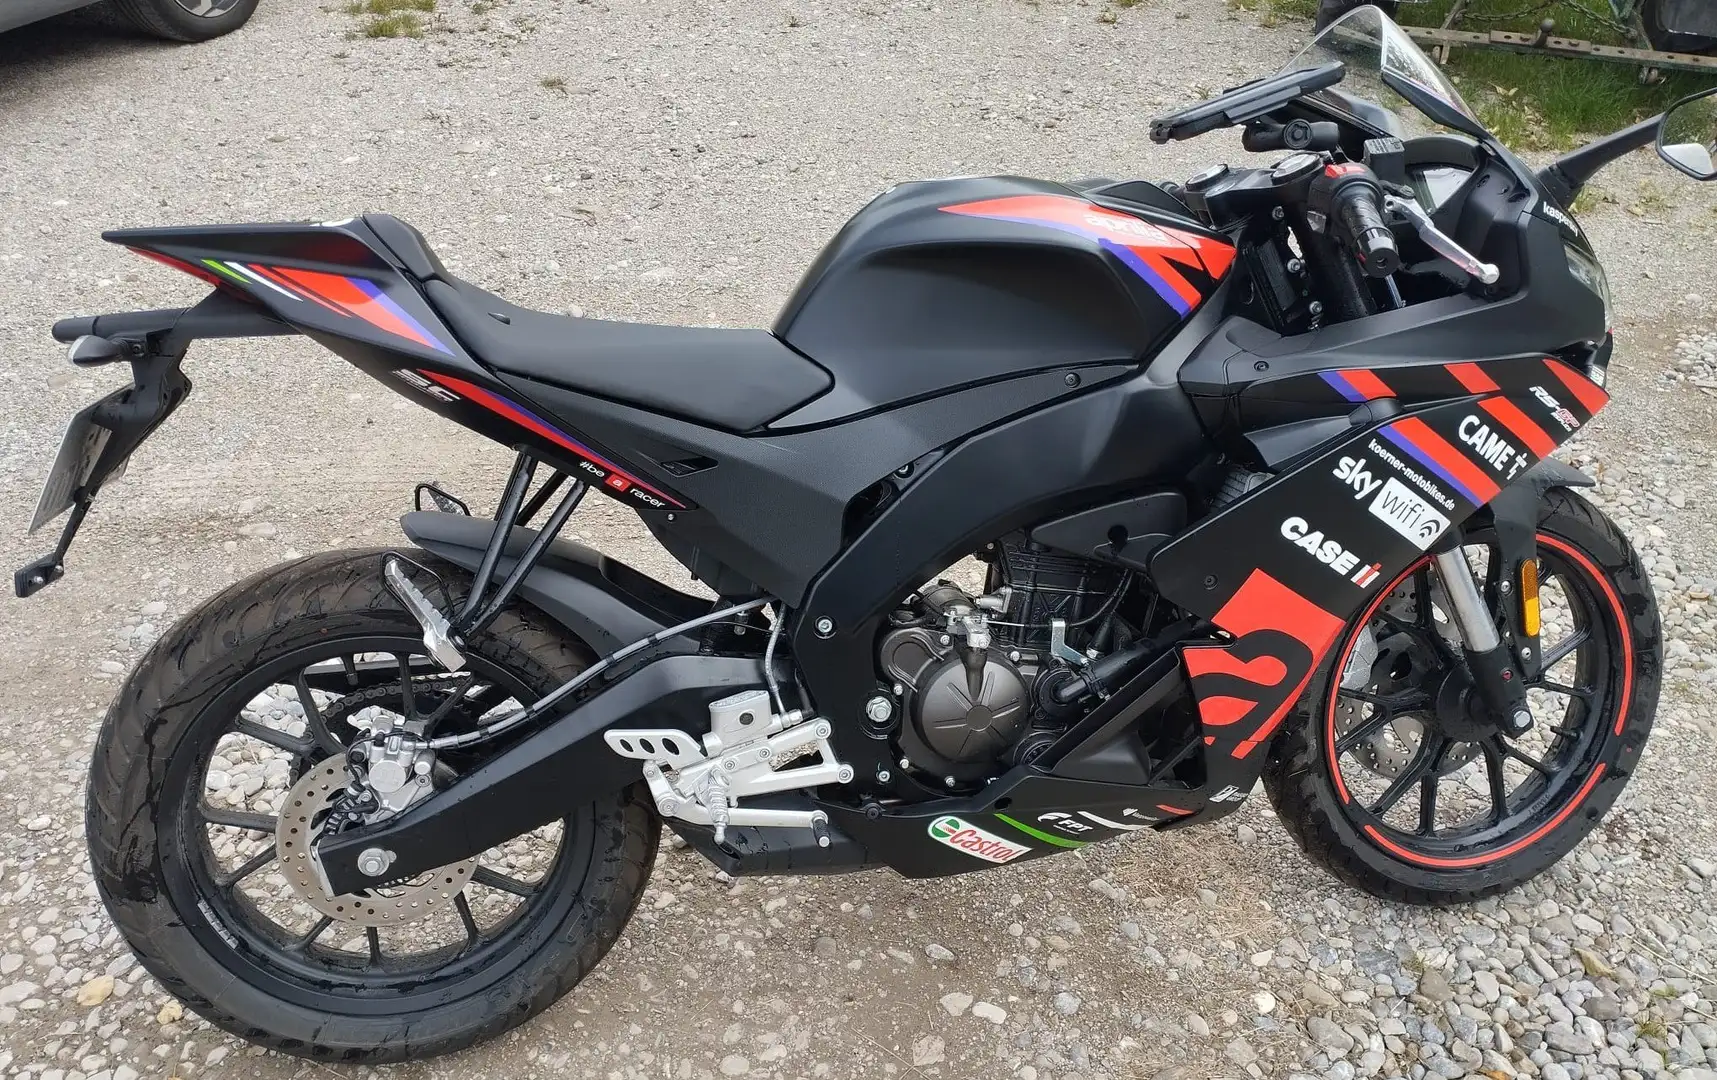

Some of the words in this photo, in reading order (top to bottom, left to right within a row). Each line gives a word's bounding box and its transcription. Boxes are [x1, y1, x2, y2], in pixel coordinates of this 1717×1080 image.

[1457, 414, 1510, 472] CAME
[629, 488, 666, 508] racer
[1332, 455, 1384, 500] sky
[1382, 490, 1426, 521] wifi
[1368, 437, 1456, 511] koerner-motobikes.de
[1280, 516, 1361, 576] CASE
[948, 828, 1024, 862] Castrol
[1060, 819, 1094, 833] FPT
